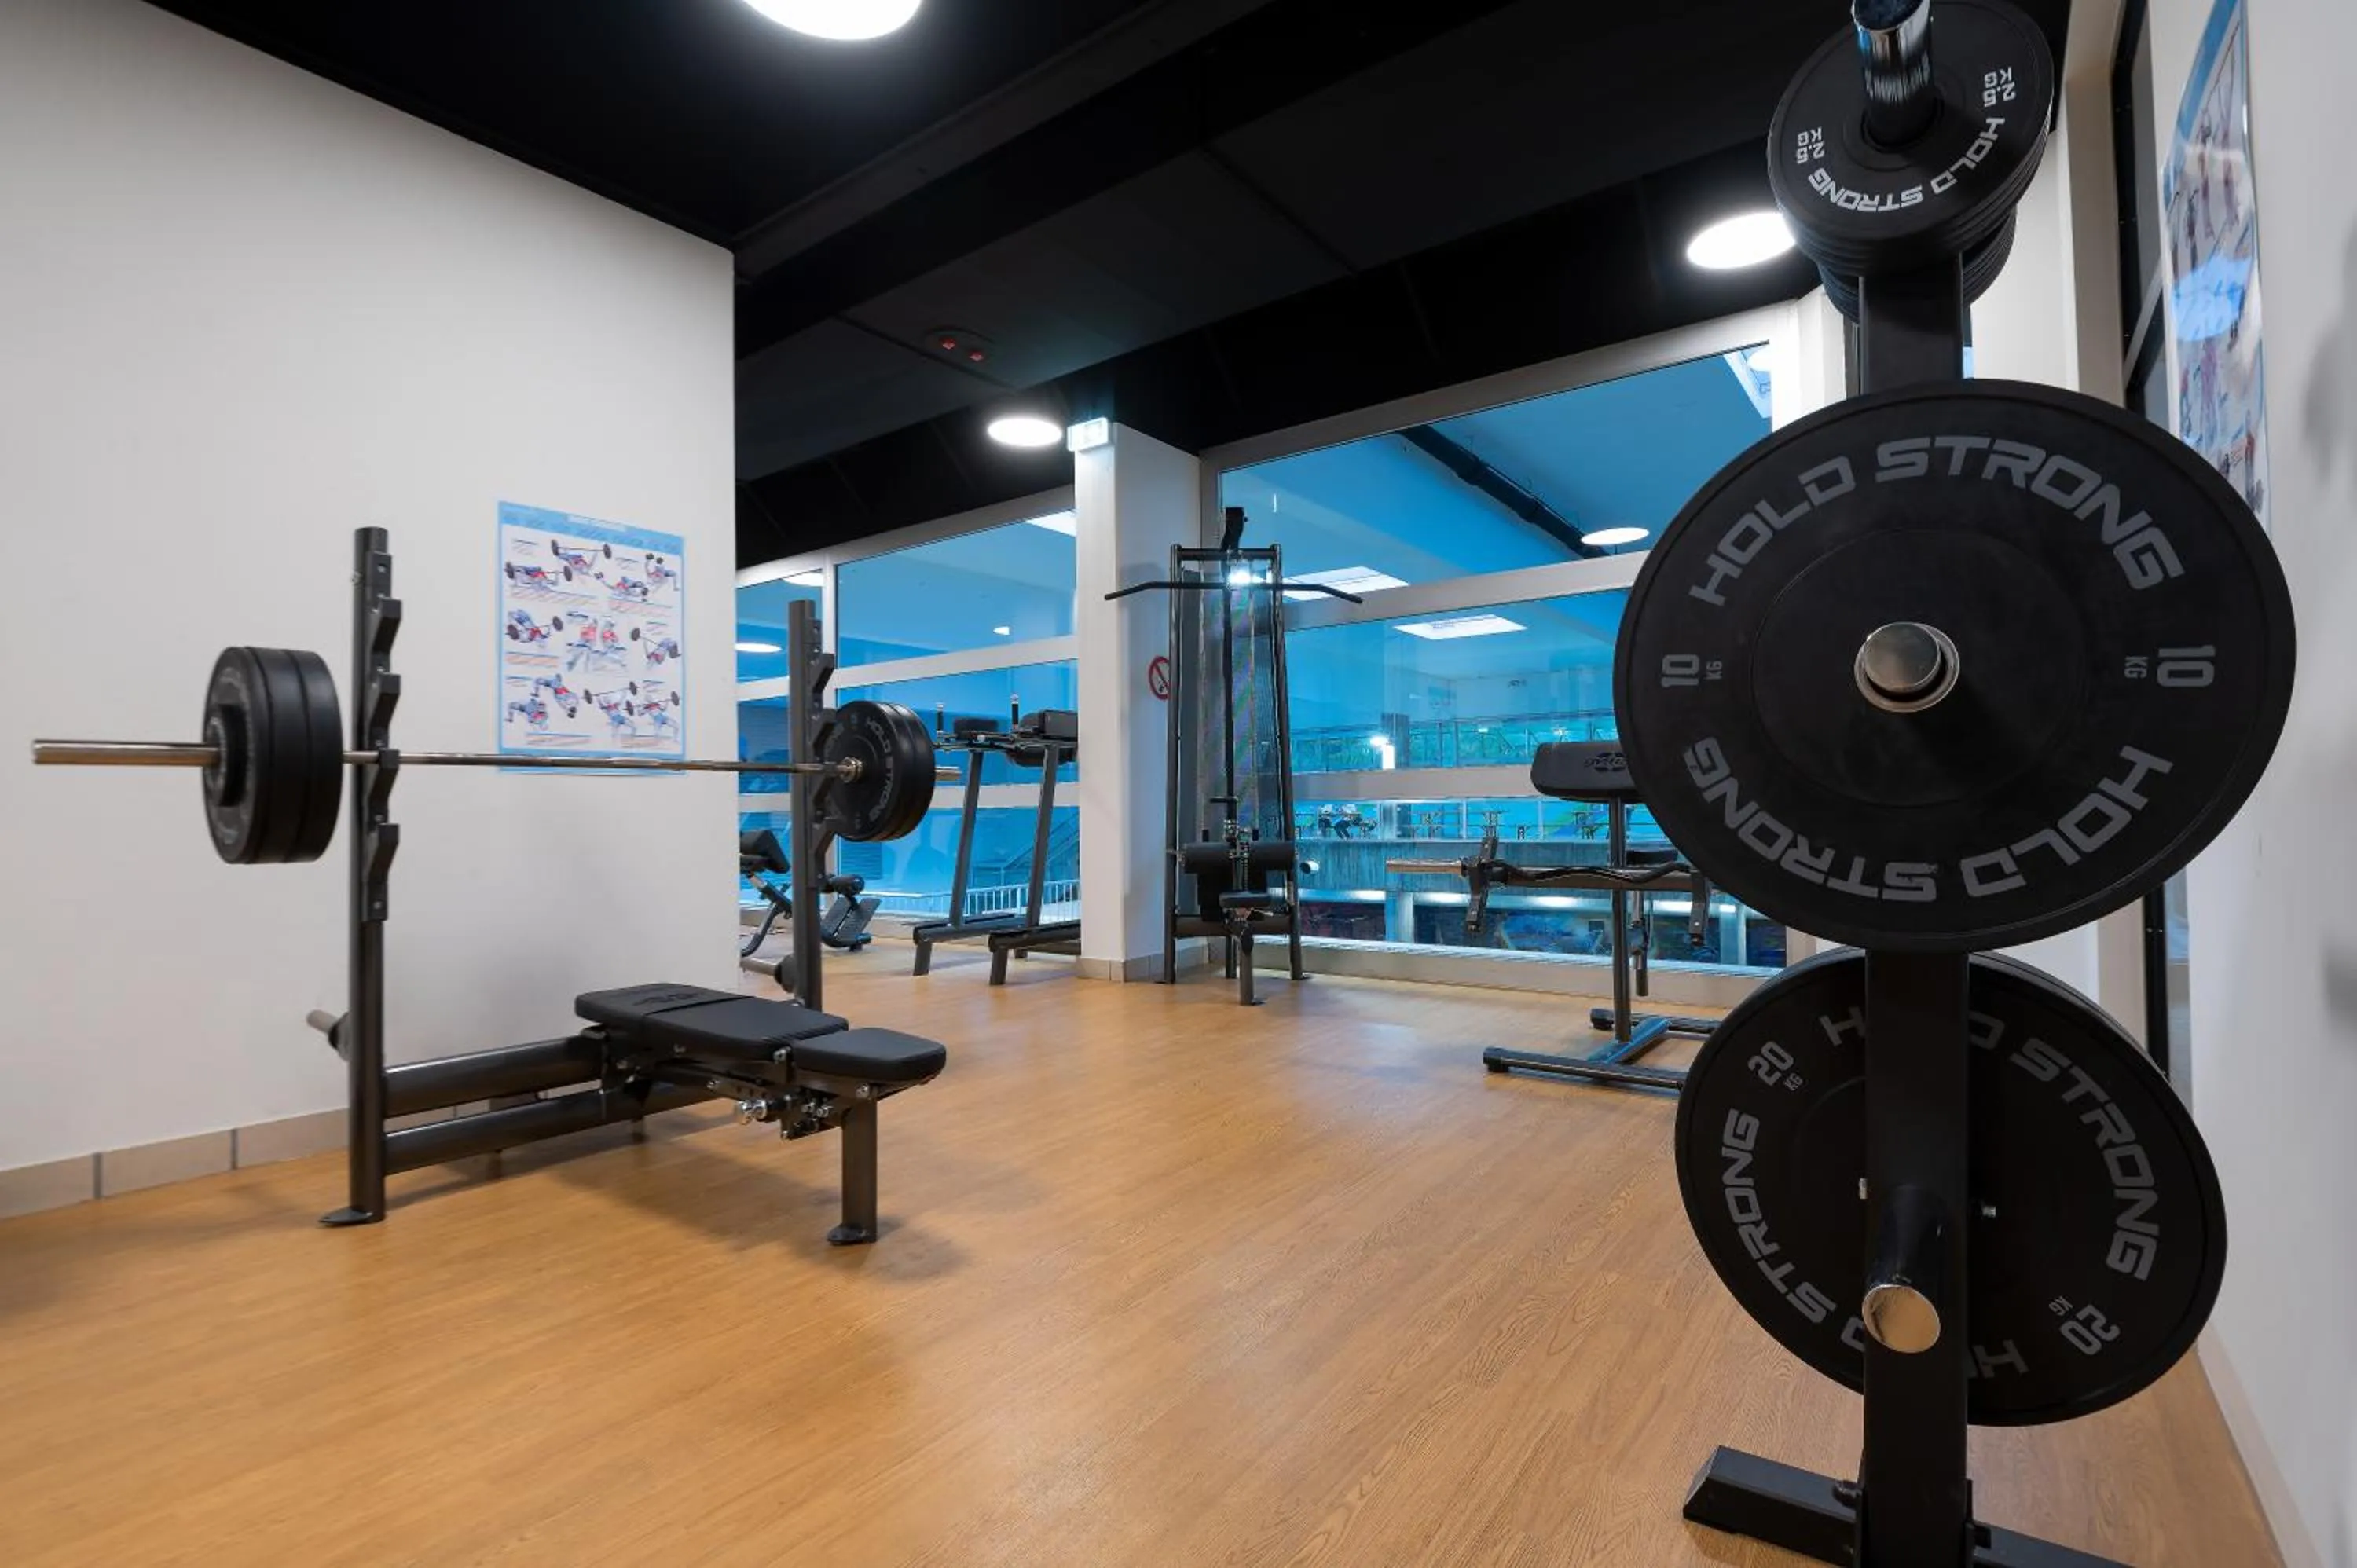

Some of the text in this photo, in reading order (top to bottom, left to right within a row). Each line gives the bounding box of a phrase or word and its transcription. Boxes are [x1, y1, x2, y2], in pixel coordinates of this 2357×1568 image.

[1983, 81, 2016, 108] 2.5
[1984, 67, 2012, 87] KG
[1796, 141, 1825, 164] 2.5
[1797, 126, 1822, 146] KG
[1808, 116, 2005, 213] HOLD STRONG
[1689, 435, 2185, 606] HOLD STRONG
[1662, 653, 1723, 688] 10 KG
[2123, 644, 2216, 688] 10 KG
[1682, 737, 2174, 902] HOLD STRONG
[1747, 1041, 1804, 1091] 20 KG
[2010, 1037, 2160, 1281] STRONG
[1721, 1108, 1837, 1324] STRONG
[2048, 1295, 2121, 1356] 20 KG
